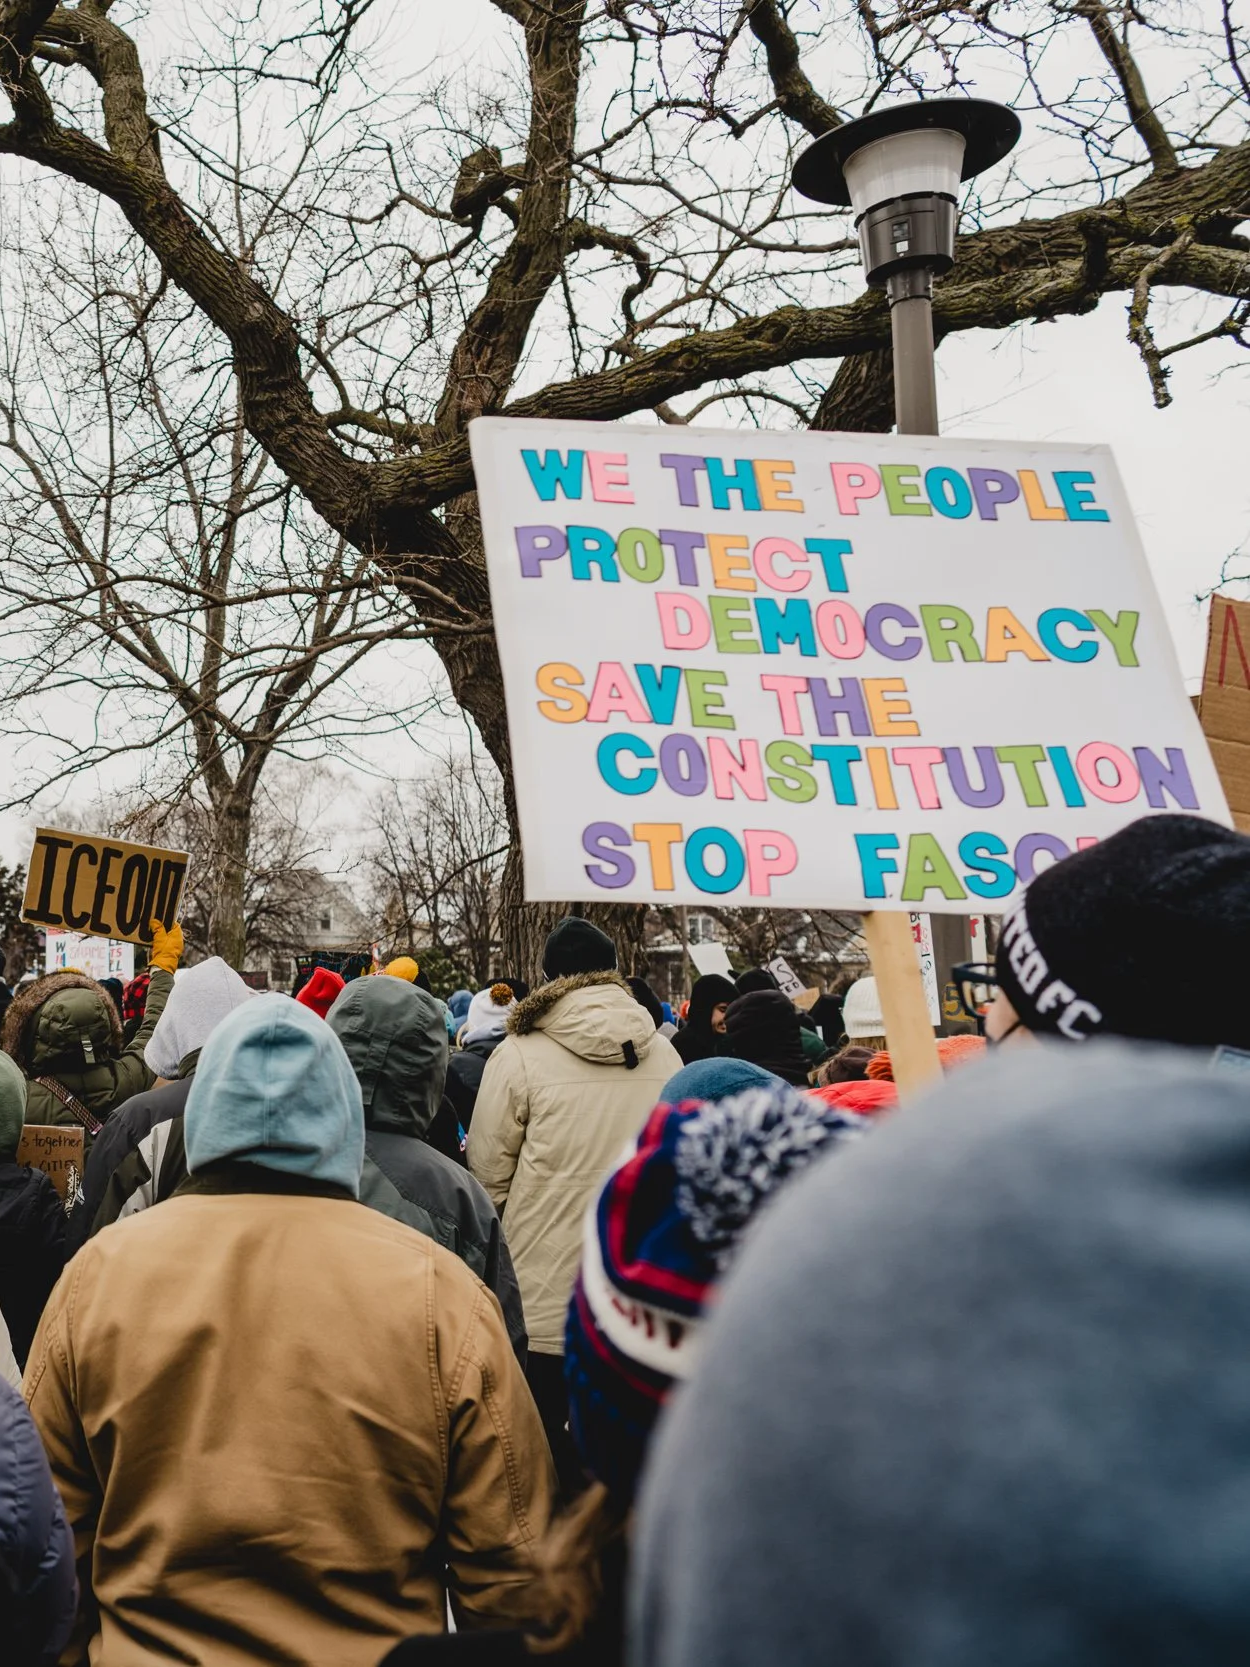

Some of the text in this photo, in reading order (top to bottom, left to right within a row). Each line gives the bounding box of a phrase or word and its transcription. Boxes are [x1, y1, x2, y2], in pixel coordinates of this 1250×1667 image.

[520, 448, 1111, 523] WE THE PEOPLE
[515, 524, 853, 593] PROTECT
[655, 591, 1140, 668] DEMOCRACY
[535, 662, 920, 738] SAVE THE
[596, 732, 1200, 811] CONSTITUTION
[581, 821, 1101, 901] STOP FASC
[1035, 979, 1103, 1041] FC
[32, 1133, 82, 1155] together
